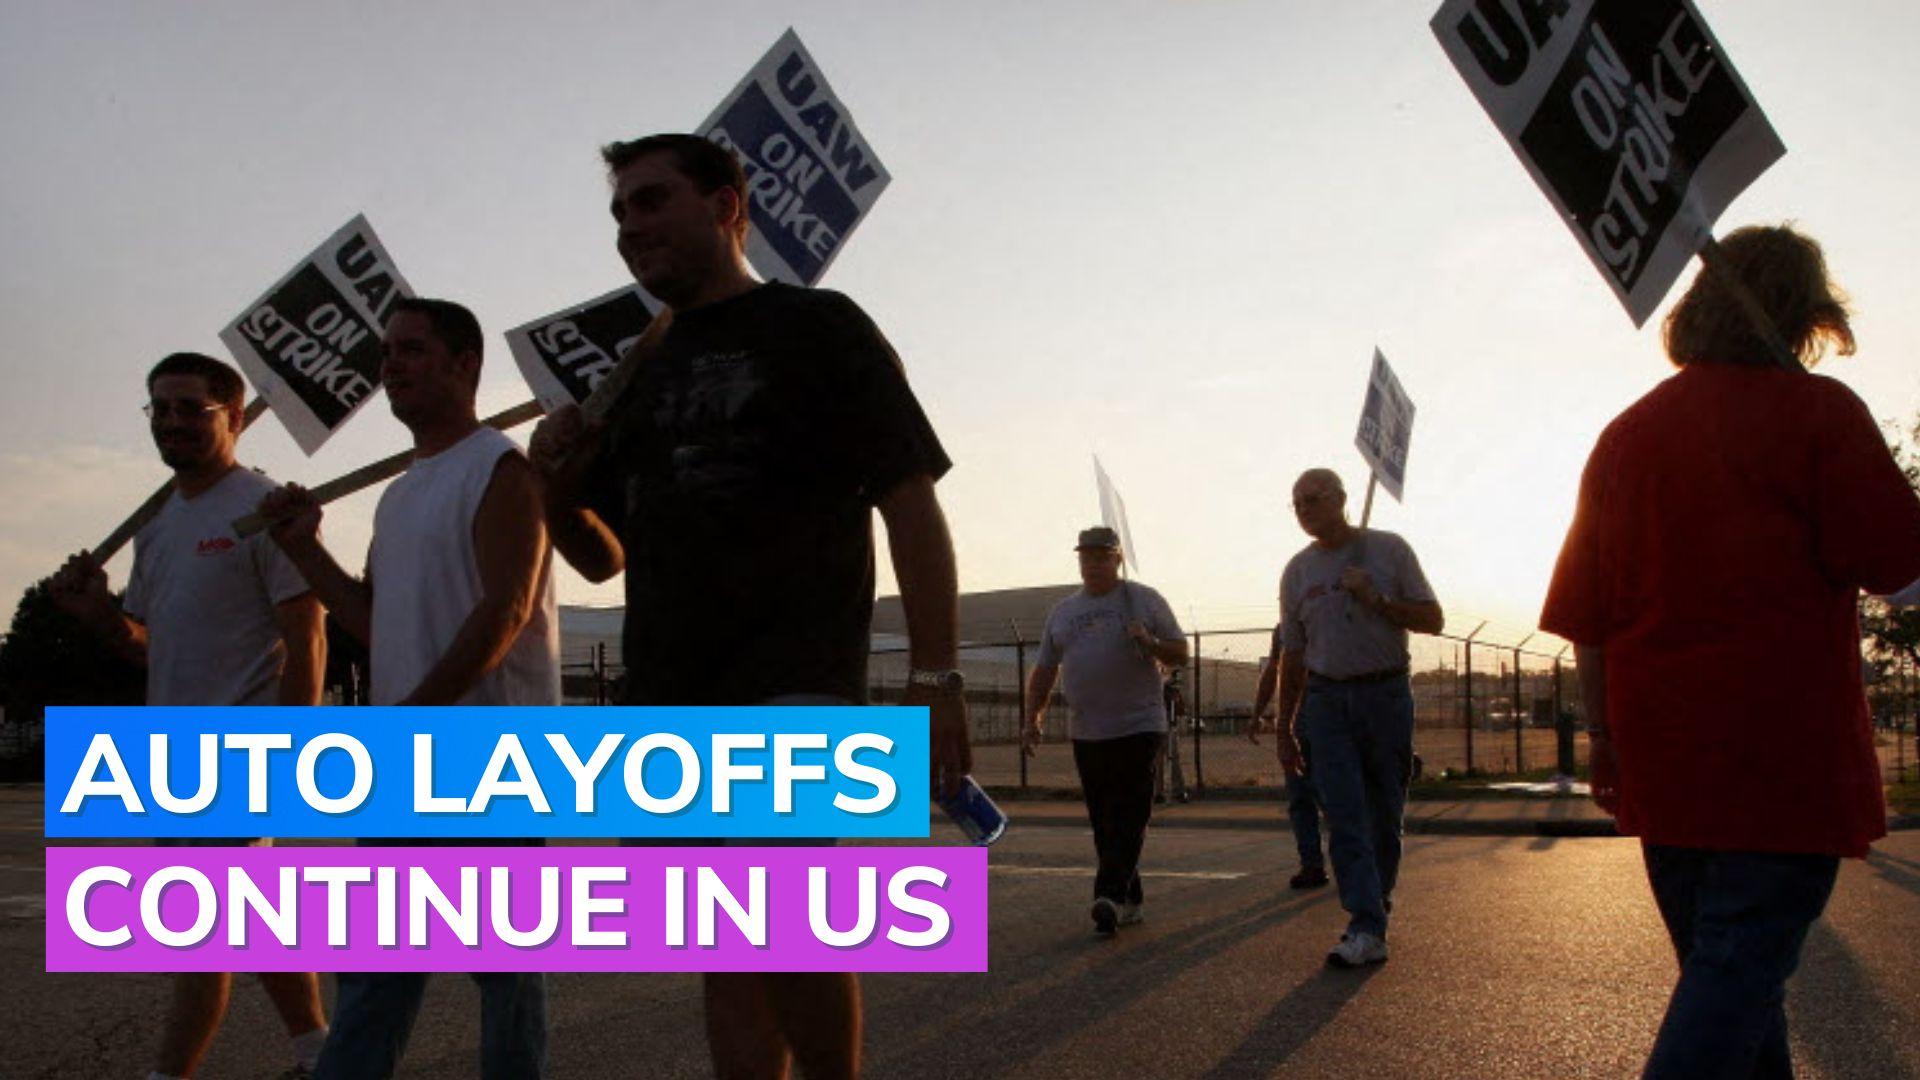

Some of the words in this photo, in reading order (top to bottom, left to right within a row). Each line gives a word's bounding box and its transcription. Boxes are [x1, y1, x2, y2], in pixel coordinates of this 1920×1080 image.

[1458, 0, 1571, 86] UA
[1571, 22, 1632, 150] ON
[760, 132, 824, 196] ON
[776, 51, 878, 192] UAW
[1591, 10, 1717, 283] STRIKE
[305, 302, 369, 353] ON
[336, 232, 400, 330] UA
[243, 304, 375, 408] STRIKE
[535, 320, 618, 392] STR
